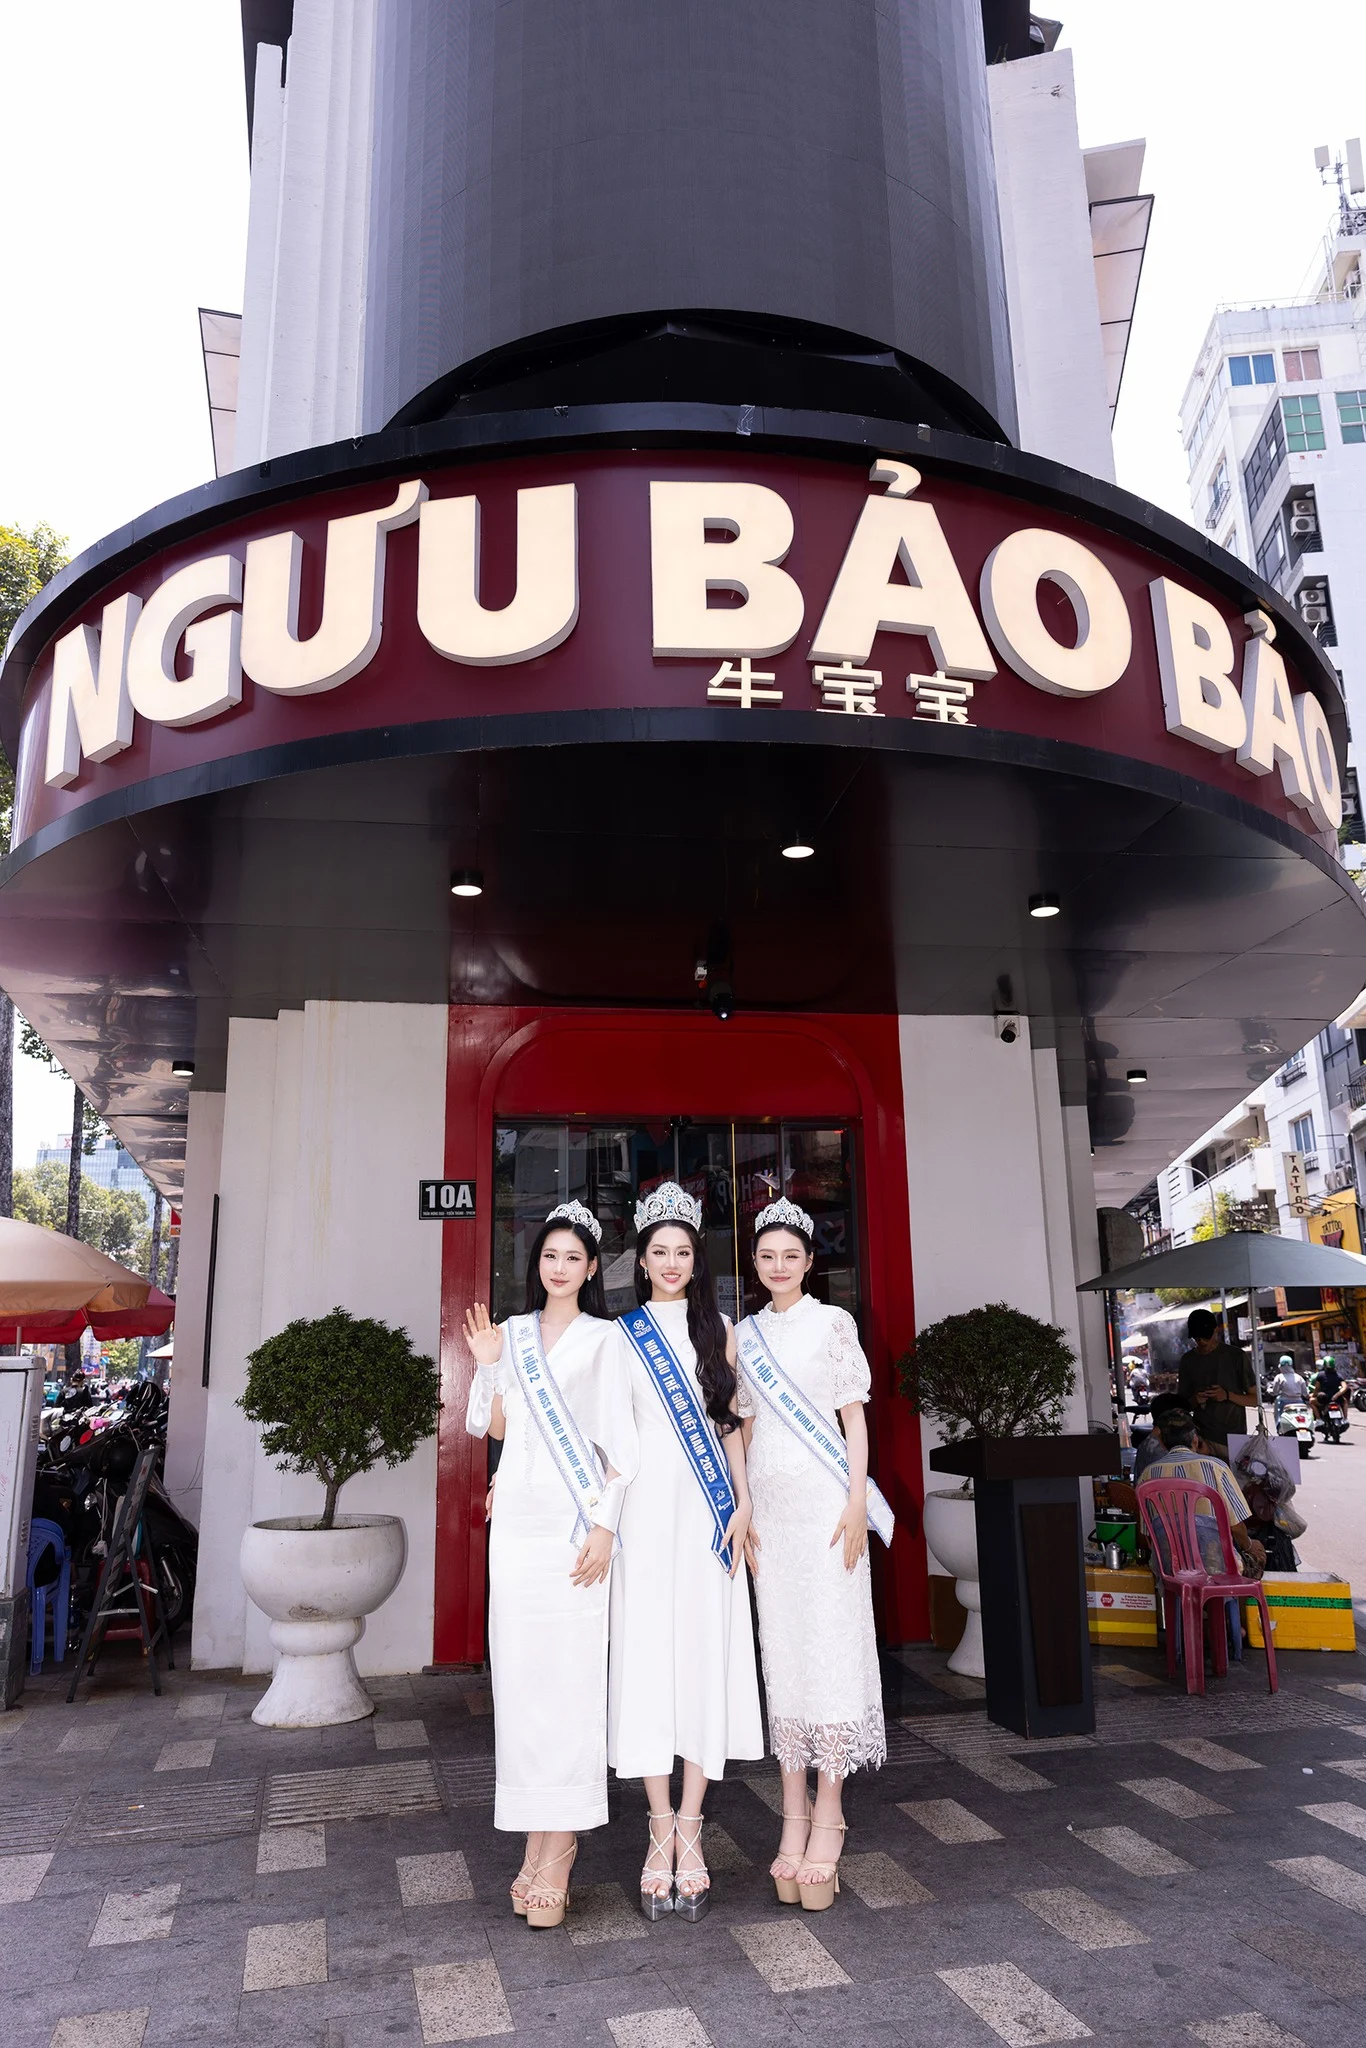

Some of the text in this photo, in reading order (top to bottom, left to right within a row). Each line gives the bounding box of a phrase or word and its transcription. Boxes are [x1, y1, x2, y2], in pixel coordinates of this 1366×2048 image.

[44, 458, 1344, 833] NGƯU BẢO BẢO
[706, 658, 978, 727] 牛宝宝
[425, 1185, 473, 1209] 10A
[1289, 1155, 1304, 1214] TATTOO
[1322, 1220, 1342, 1234] TATTOO
[522, 1354, 539, 1375] HẬU
[530, 1374, 541, 1383] 2
[536, 1388, 551, 1408] MISS
[644, 1339, 717, 1483] HOA HẬU THẾ GIỚI VIỆT NAM 2025
[545, 1407, 564, 1435] WORLD
[752, 1355, 850, 1476] Á HẬU 1 MISS WORLD VIETNAM 202
[558, 1434, 581, 1468] VIETNAM
[575, 1467, 591, 1490] 2025
